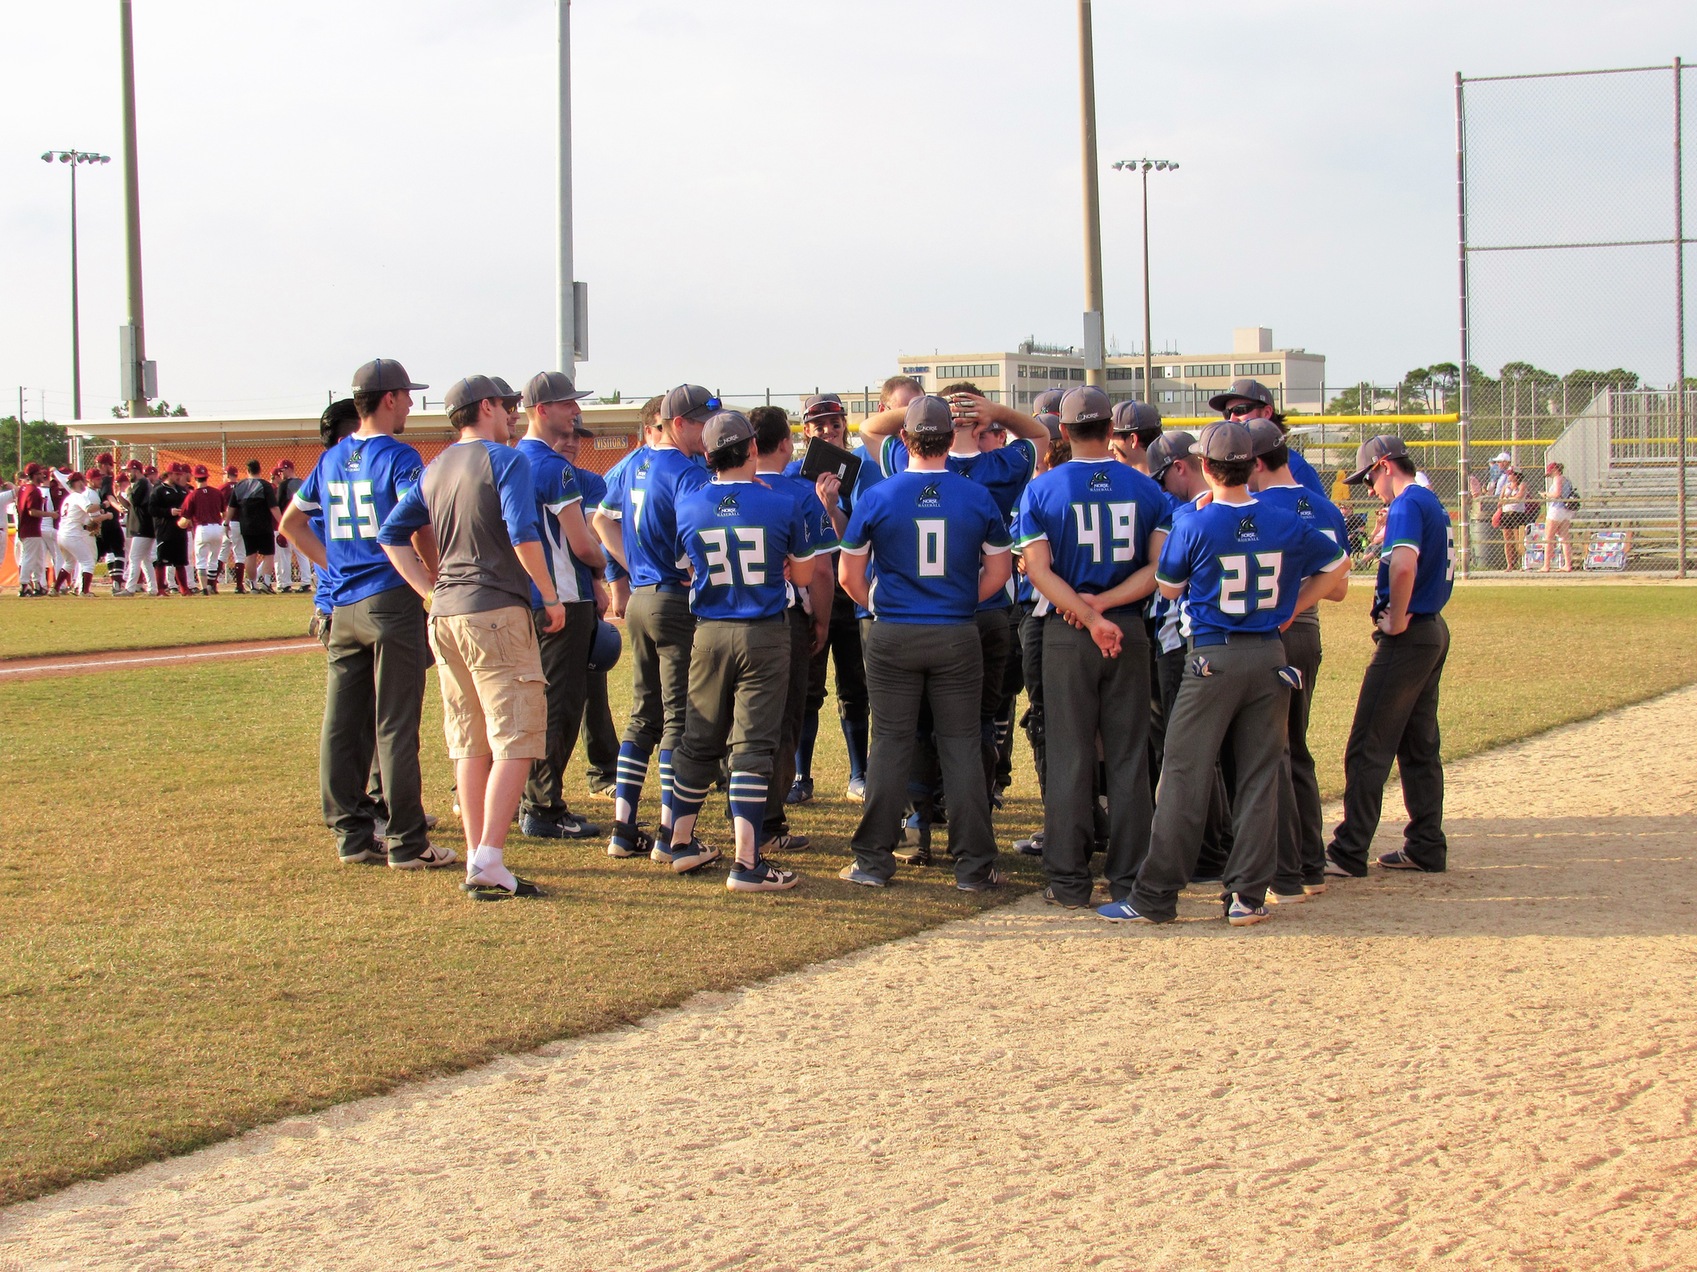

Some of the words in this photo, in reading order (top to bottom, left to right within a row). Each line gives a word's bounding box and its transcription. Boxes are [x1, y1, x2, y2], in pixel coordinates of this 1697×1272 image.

[595, 437, 626, 449] VISITORS
[327, 480, 380, 541] 25
[630, 489, 646, 546] 7
[1071, 502, 1138, 563] 49
[697, 526, 768, 587] 32
[913, 518, 948, 579] 0
[1217, 552, 1283, 615] 23
